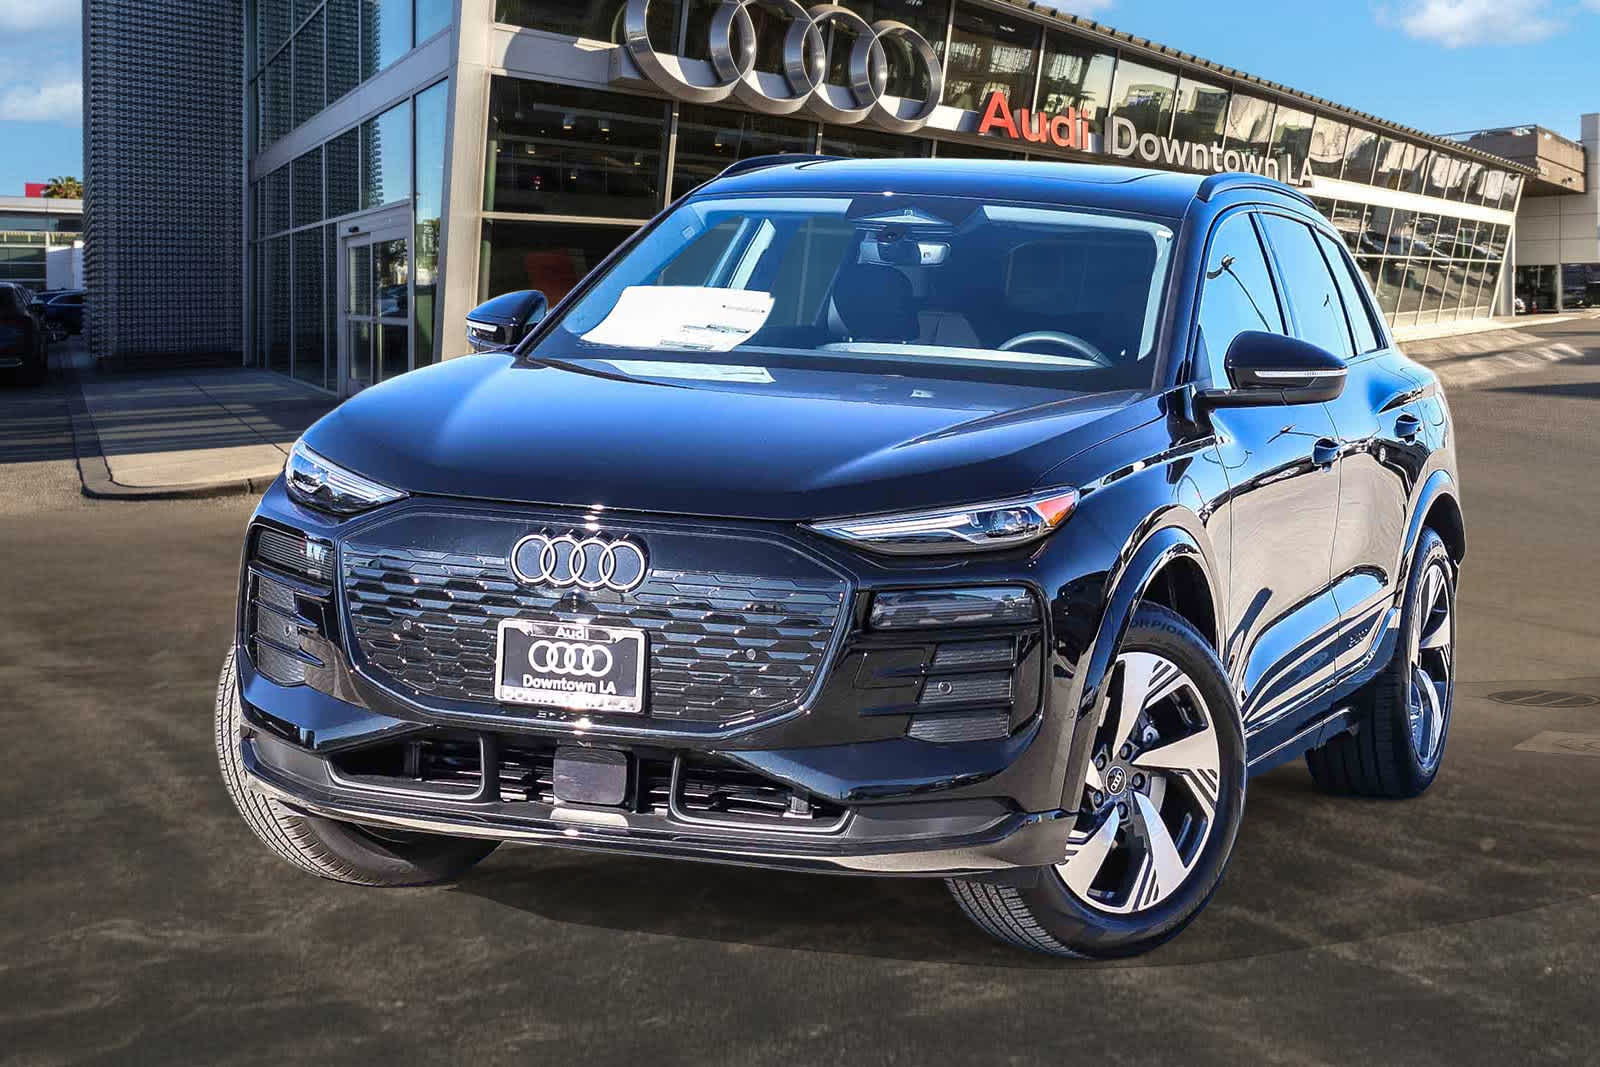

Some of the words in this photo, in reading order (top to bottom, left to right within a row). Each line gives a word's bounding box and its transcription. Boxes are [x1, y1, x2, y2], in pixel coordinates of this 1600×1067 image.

[978, 91, 1089, 151] Audi
[1105, 115, 1280, 181] Downtown
[1286, 153, 1315, 188] LA
[555, 626, 589, 640] Audi
[1132, 618, 1188, 640] ORPION
[522, 673, 597, 694] Downtown
[599, 679, 617, 695] LA
